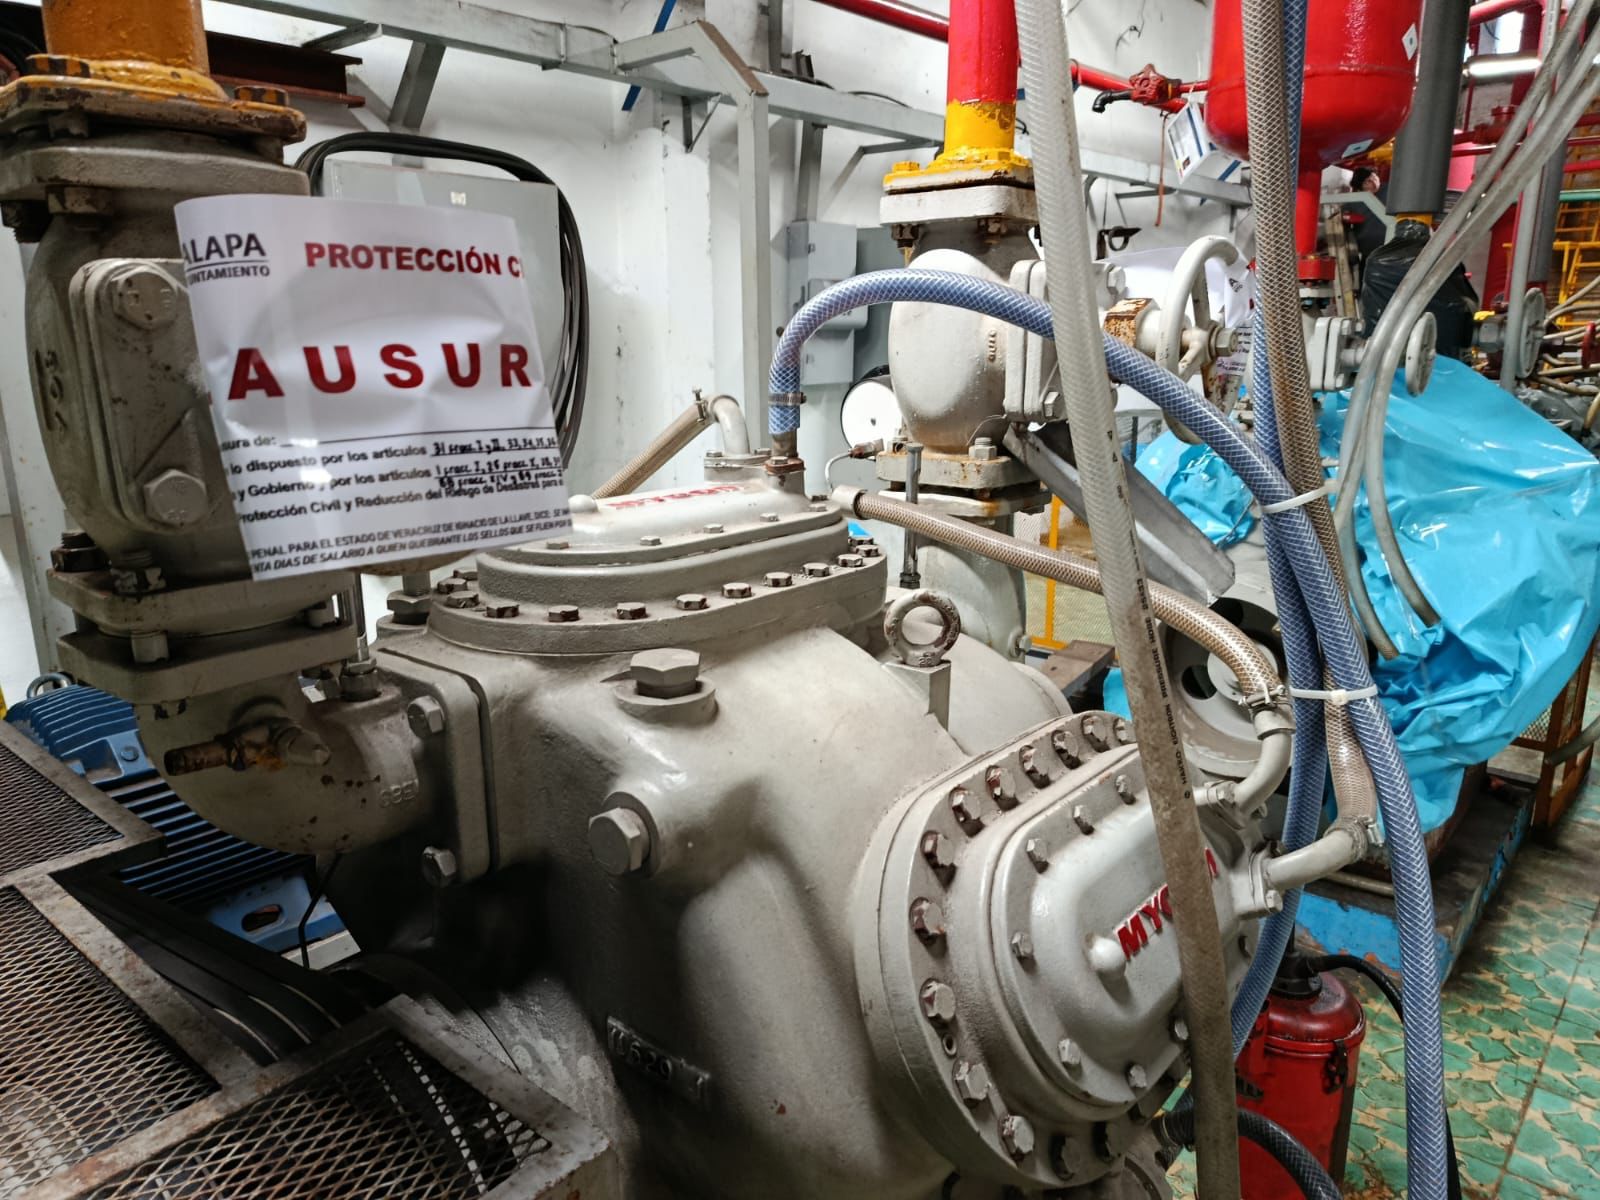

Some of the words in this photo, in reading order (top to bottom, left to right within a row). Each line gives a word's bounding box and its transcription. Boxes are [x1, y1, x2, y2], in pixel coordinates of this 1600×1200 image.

[304, 242, 502, 276] PROTECCIÓN
[246, 455, 317, 473] dispuesto
[321, 454, 343, 467] por
[347, 450, 368, 462] los
[373, 445, 427, 459] artículos
[237, 490, 245, 502] y
[248, 481, 315, 497] Gobierno
[329, 476, 351, 490] por
[355, 473, 375, 485] los
[378, 467, 432, 482] artículos
[238, 504, 308, 524] rotección
[310, 499, 342, 514] Civil
[345, 500, 351, 512] y
[355, 492, 423, 509] Reducción
[425, 488, 442, 501] del
[482, 484, 494, 494] de
[251, 546, 287, 560] PENAL
[288, 541, 319, 554] PARA
[320, 538, 334, 549] EL
[335, 532, 376, 546] ESTADO
[377, 530, 392, 541] DE
[393, 524, 441, 539] VERACRUZ
[442, 523, 454, 532] DE
[455, 518, 487, 531] IGNACIO
[487, 516, 498, 526] DE
[499, 514, 509, 525] LA
[273, 558, 300, 571] DIAS
[302, 554, 318, 565] DE
[319, 547, 365, 562] SALARIO
[366, 546, 375, 556] A
[376, 541, 407, 555] QUIEN
[408, 533, 461, 549] QUEBRANTE
[463, 530, 479, 542] LOS
[480, 526, 509, 540] SELLOS
[510, 525, 523, 535] QUE
[525, 523, 535, 533] SE
[1145, 616, 1157, 643] HOSE
[1151, 647, 1168, 698] PRESSURE
